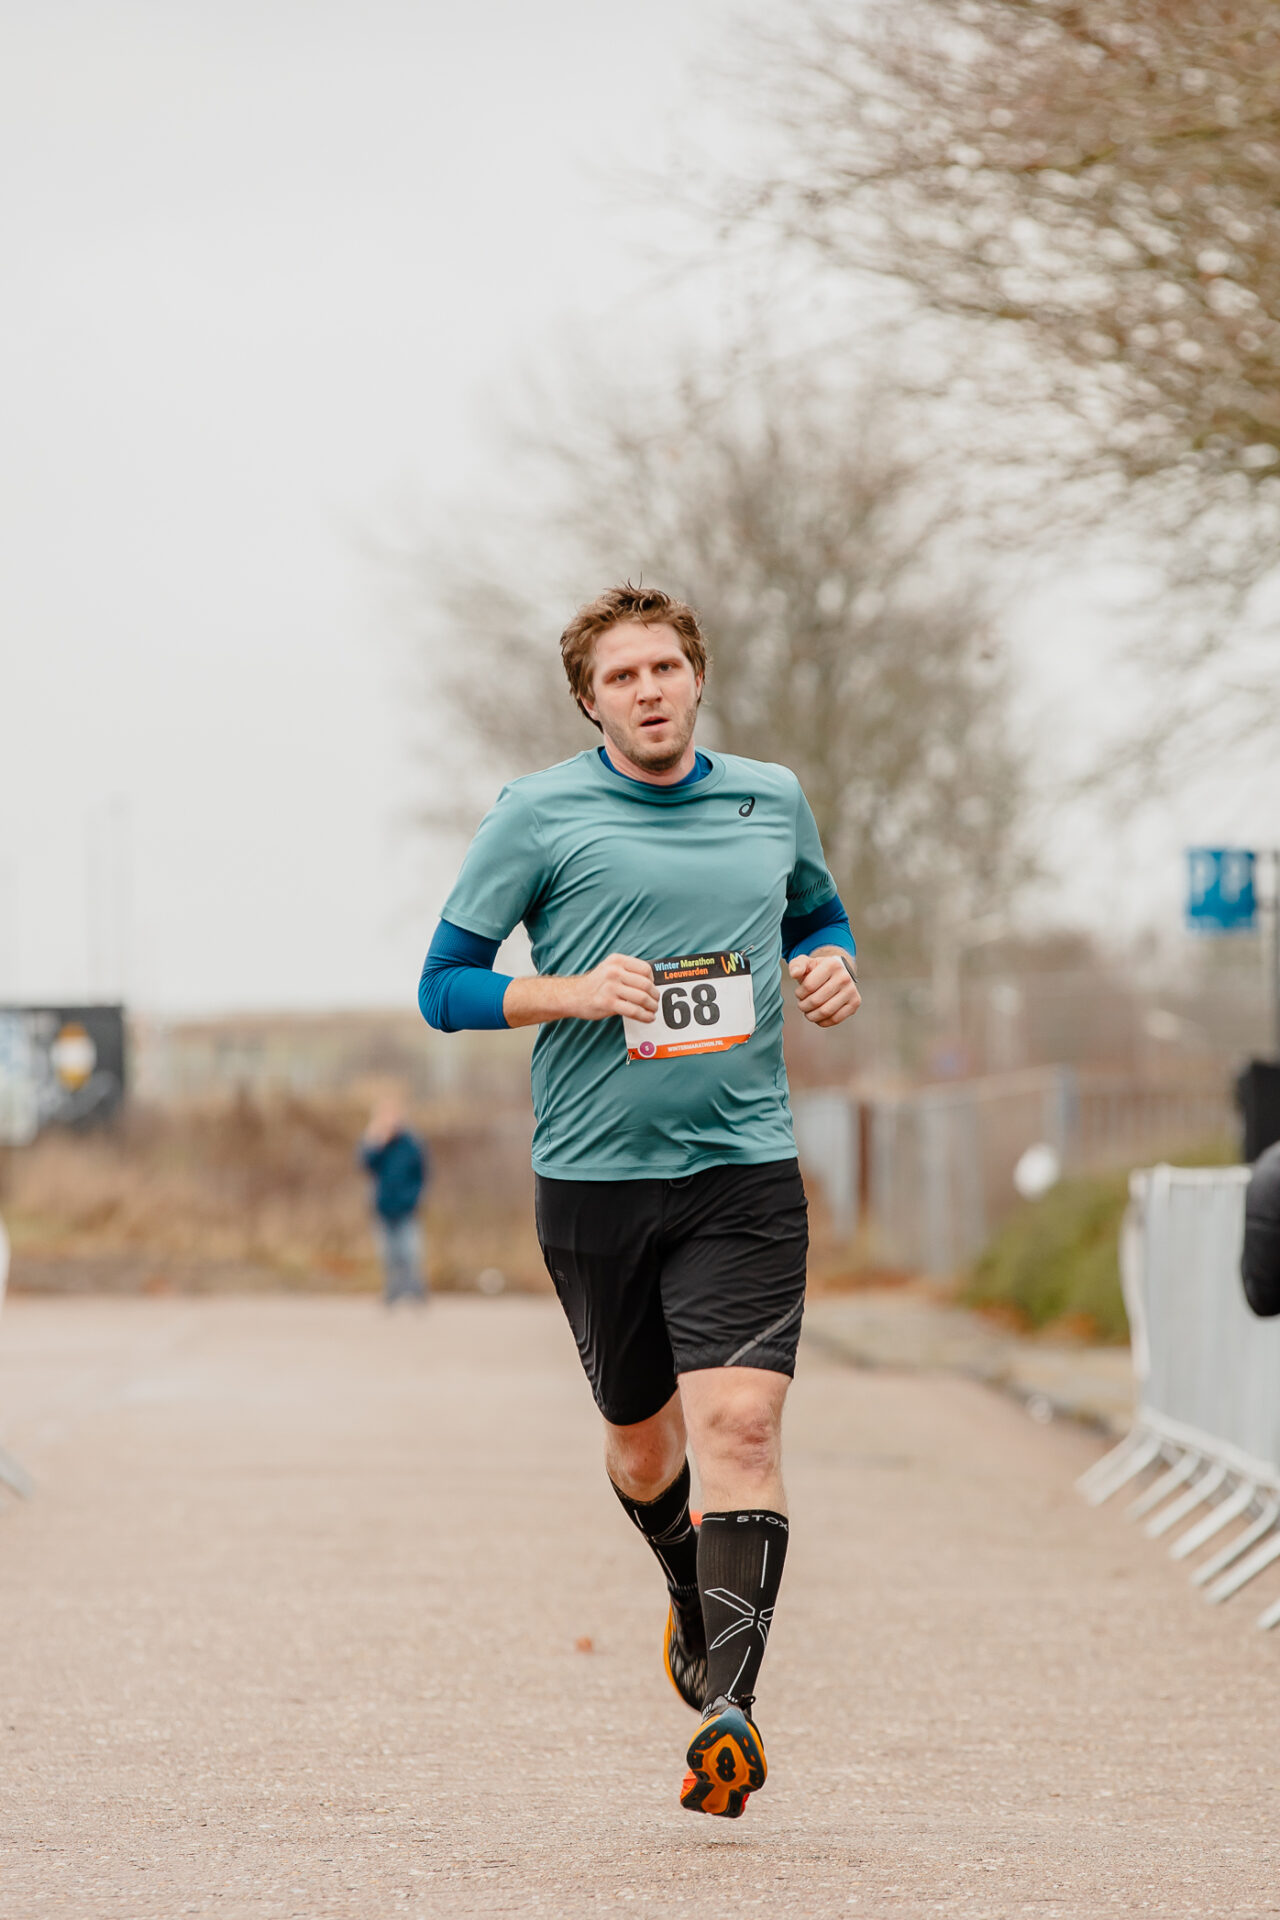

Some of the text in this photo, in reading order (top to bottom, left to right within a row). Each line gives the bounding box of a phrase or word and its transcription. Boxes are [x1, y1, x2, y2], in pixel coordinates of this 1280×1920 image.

[654, 957, 715, 972] Winter Marathon
[664, 967, 708, 980] Leeuwarden
[661, 983, 720, 1030] 68
[736, 1514, 788, 1532] STOX
